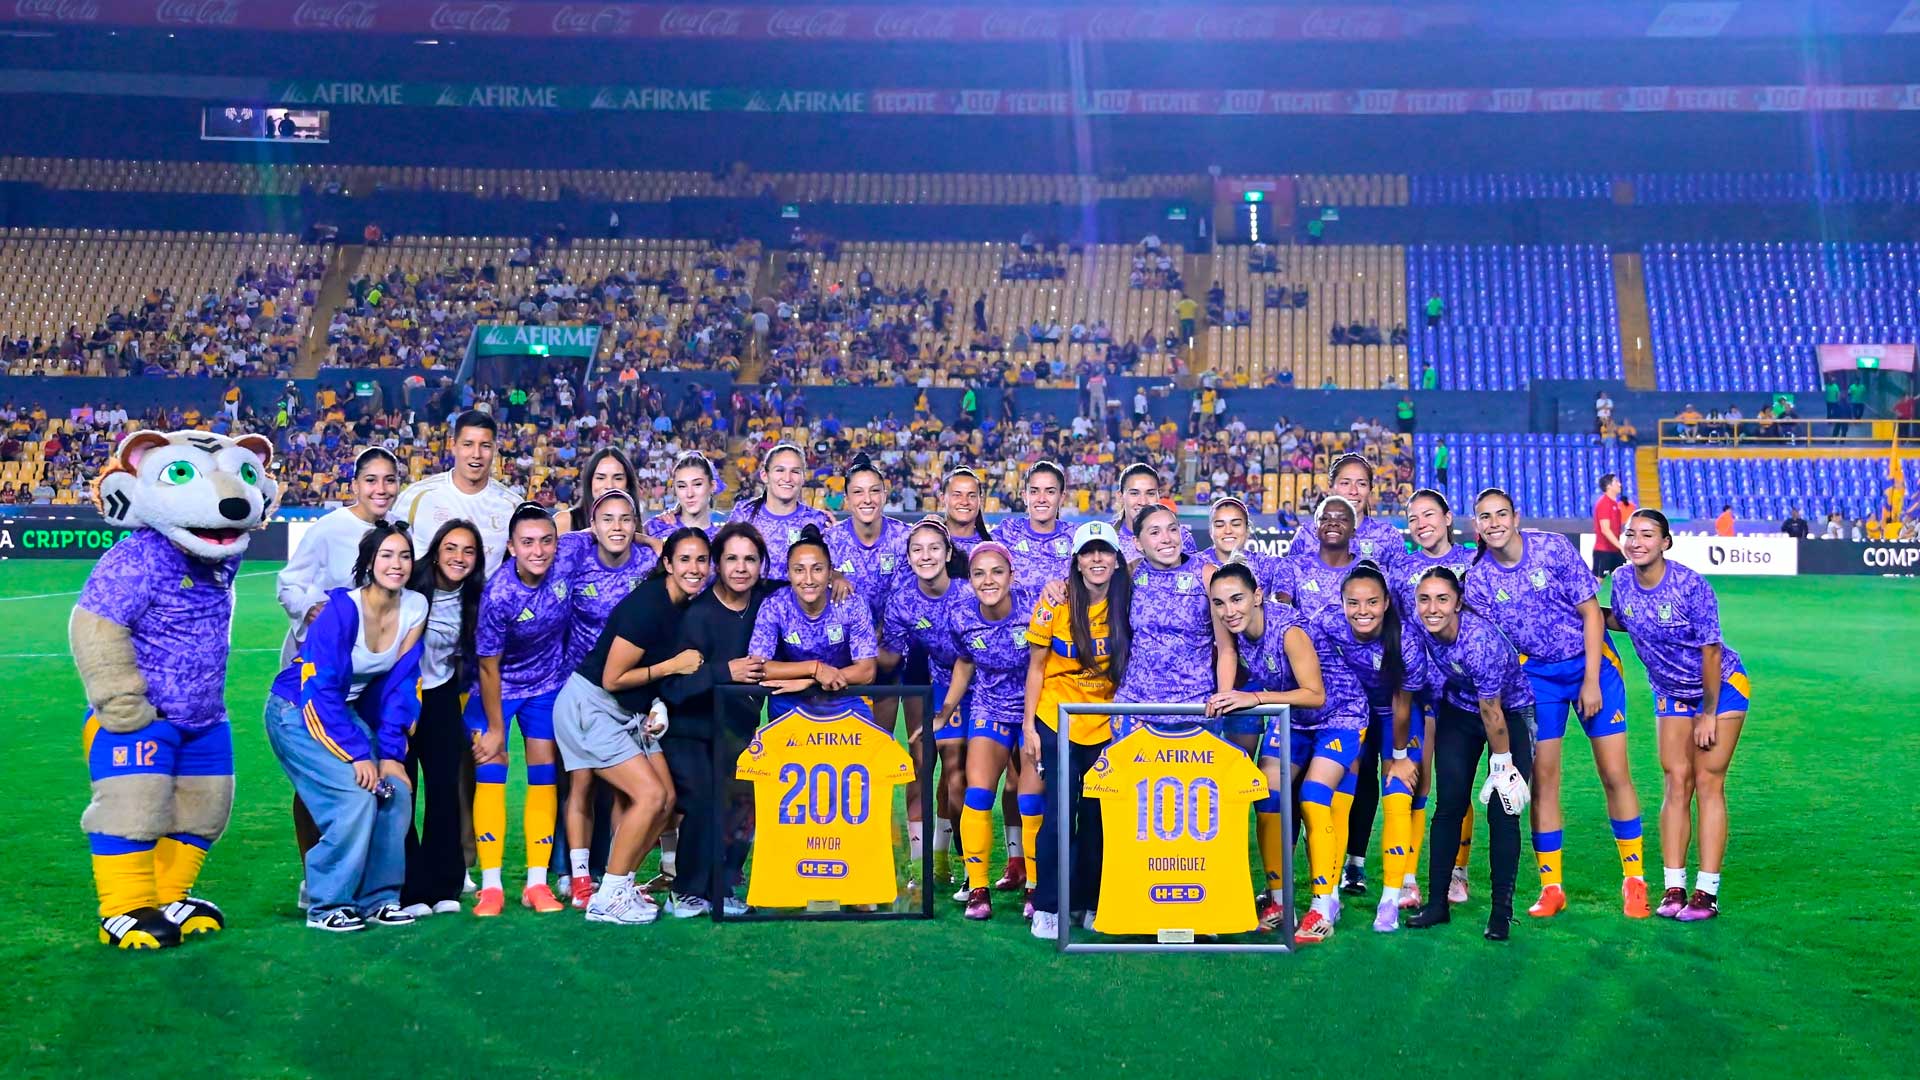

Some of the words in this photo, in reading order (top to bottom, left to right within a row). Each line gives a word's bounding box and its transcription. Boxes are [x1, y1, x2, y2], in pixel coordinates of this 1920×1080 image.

[313, 84, 403, 104] AFIRME
[469, 86, 558, 108] AFIRME
[623, 90, 711, 110] AFIRME
[776, 92, 865, 112] AFIRME
[873, 93, 937, 112] TECATE
[514, 327, 597, 346] AFIRME
[22, 530, 113, 549] CRIPTOS
[1730, 549, 1772, 563] Bitso
[1863, 547, 1920, 567] COMP
[806, 732, 862, 746] AFIRME
[135, 740, 159, 766] 12
[1154, 749, 1215, 764] AFIRME
[779, 762, 870, 825] 200
[1136, 776, 1219, 841] 100
[806, 836, 841, 850] MAYOR
[1148, 854, 1206, 872] RODRÍGUEZ
